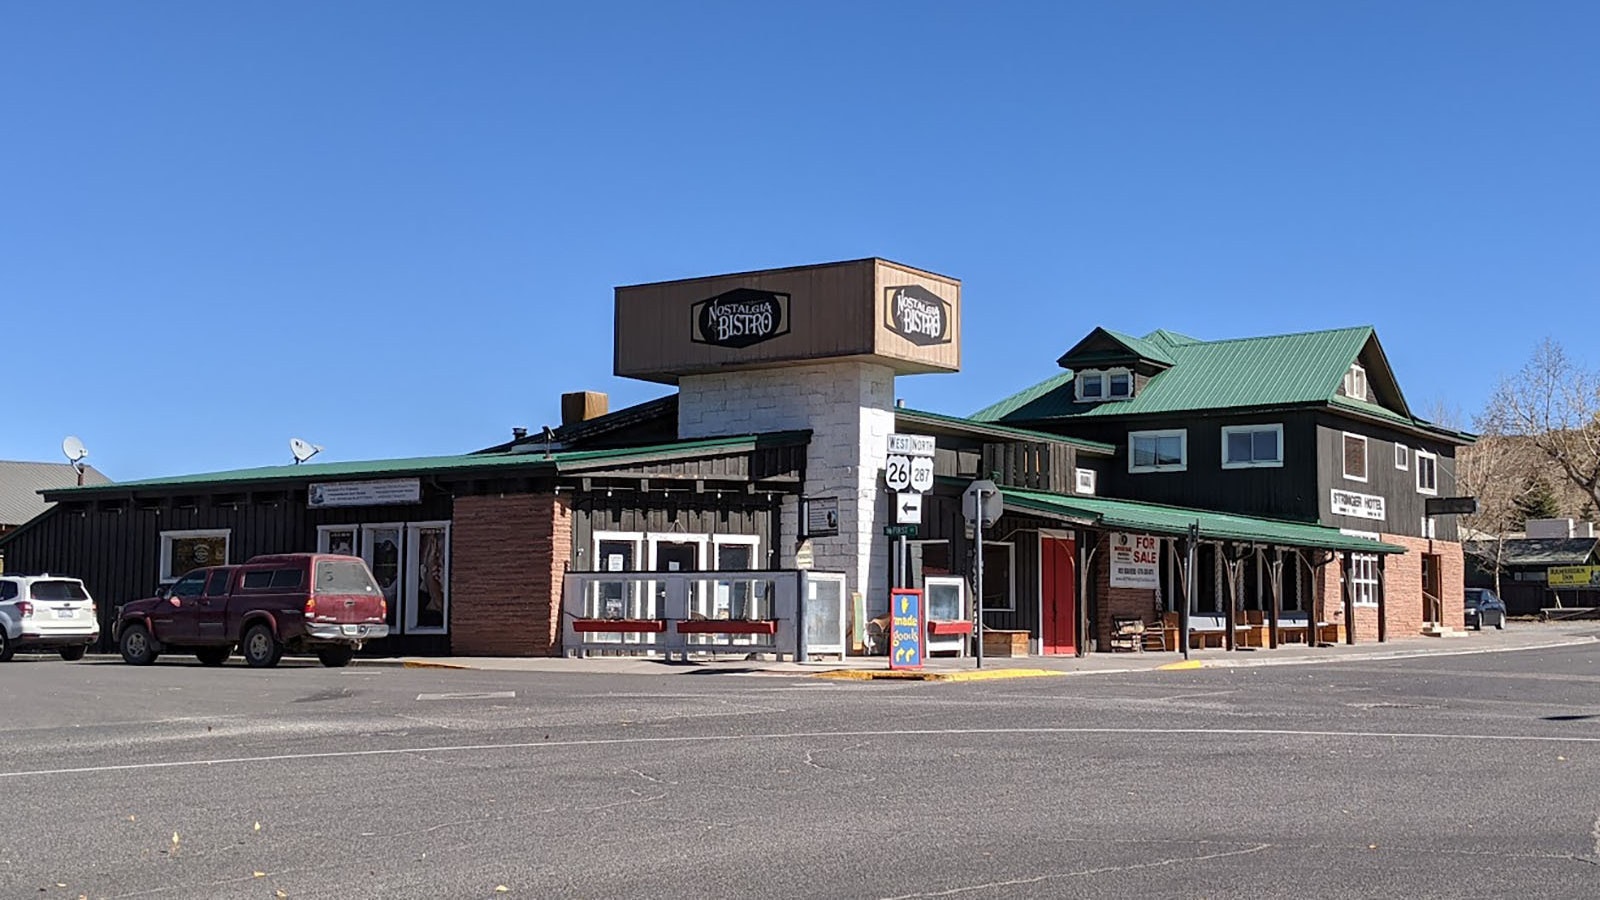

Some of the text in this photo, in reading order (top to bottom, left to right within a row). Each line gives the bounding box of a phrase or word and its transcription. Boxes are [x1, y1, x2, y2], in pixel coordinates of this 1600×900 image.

[717, 312, 772, 340] BISTRO
[903, 308, 940, 338] BISTRO
[890, 437, 909, 450] WEST
[913, 439, 933, 451] NORTH
[888, 462, 907, 483] 26
[914, 468, 930, 482] 287
[1364, 497, 1383, 511] HOTEL
[1136, 536, 1155, 549] FOR
[1133, 550, 1157, 564] SALE
[893, 615, 917, 626] made
[893, 628, 918, 647] goods
